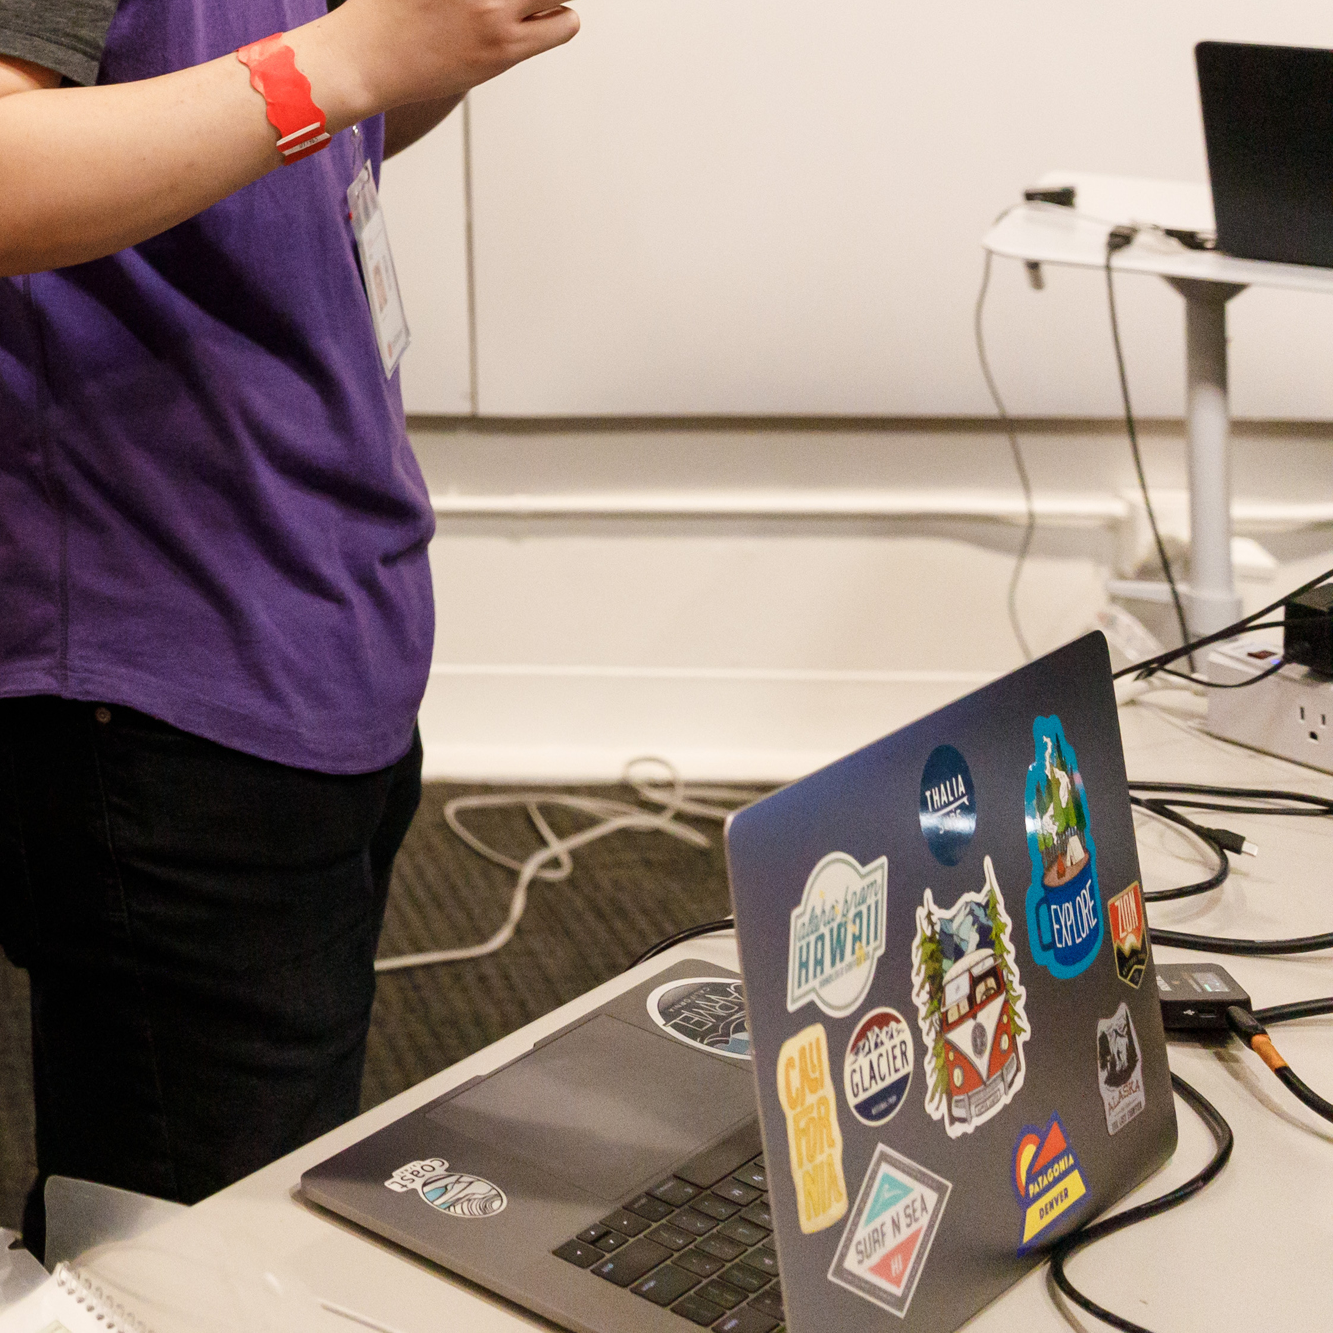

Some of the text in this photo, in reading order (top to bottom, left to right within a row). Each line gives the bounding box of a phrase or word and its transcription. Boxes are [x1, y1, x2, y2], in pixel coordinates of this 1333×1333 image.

[925, 774, 966, 812] THALIA
[1051, 879, 1097, 948] EXPLORE
[1115, 890, 1139, 939] ZION
[797, 899, 879, 990] HAWAII
[850, 1040, 909, 1099] GLACIER
[1029, 1153, 1075, 1198] PATAGONIA
[855, 1193, 928, 1265] SURF N SEA
[1039, 1187, 1069, 1220] DENVER
